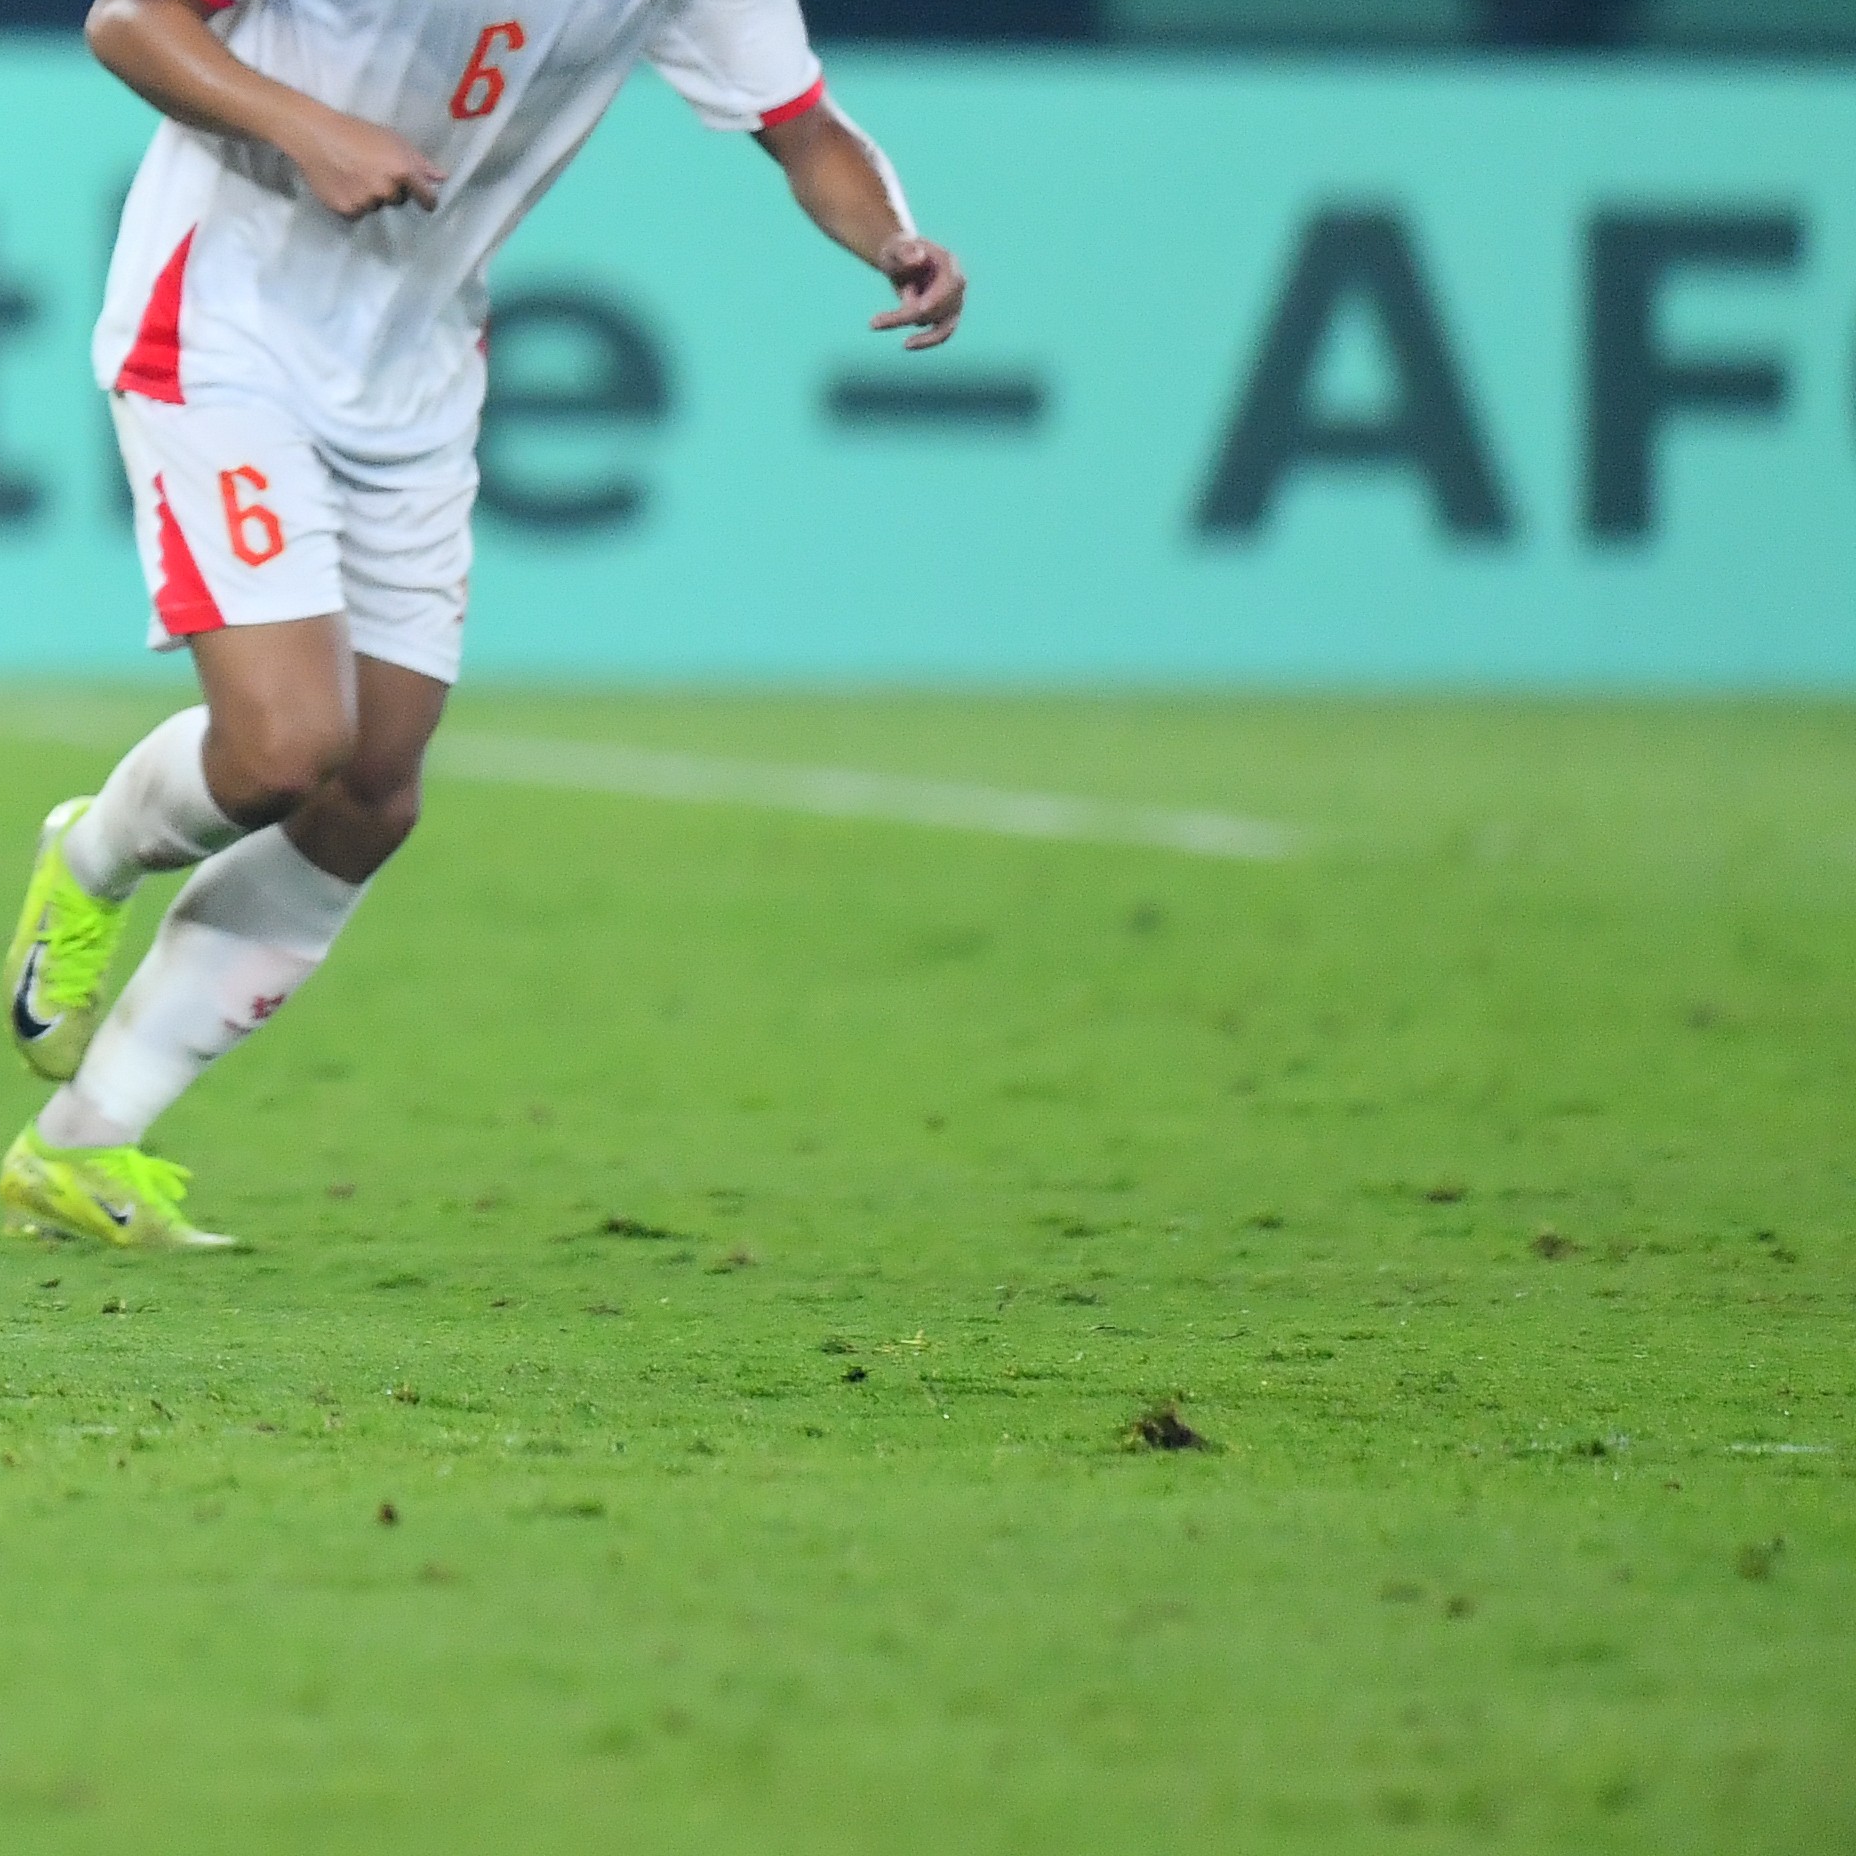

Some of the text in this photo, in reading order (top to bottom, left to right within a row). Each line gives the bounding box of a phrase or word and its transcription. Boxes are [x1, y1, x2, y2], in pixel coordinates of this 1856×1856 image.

[448, 20, 526, 121] 6
[1181, 198, 1856, 554] AF
[219, 464, 285, 568] 6
